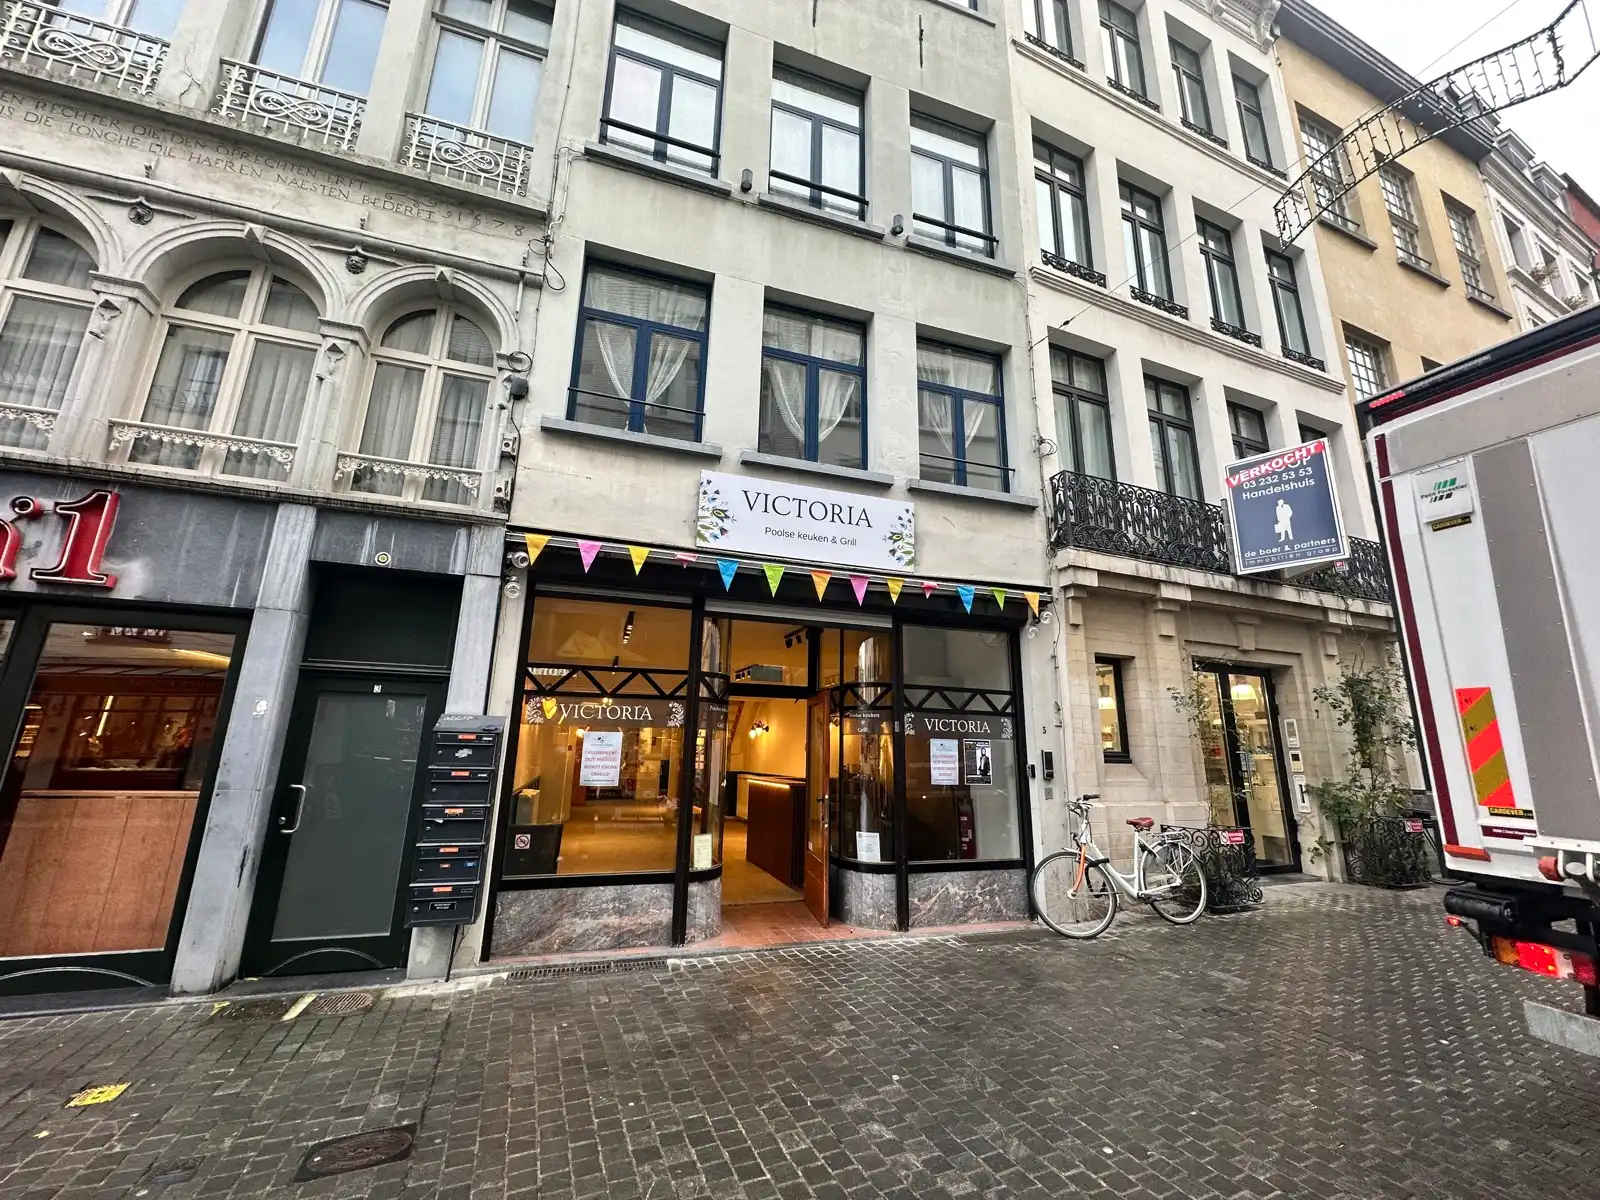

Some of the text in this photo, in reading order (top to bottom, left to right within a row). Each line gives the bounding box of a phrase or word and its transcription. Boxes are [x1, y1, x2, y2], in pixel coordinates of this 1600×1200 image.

[131, 123, 161, 140] DIE
[23, 111, 56, 128] DIE
[148, 142, 177, 158] DIE
[276, 173, 351, 200] NAESTEN
[1228, 442, 1319, 487] VERKOCHT
[1242, 467, 1313, 489] 03 232 53 53
[1242, 478, 1315, 500] Handelshuis
[741, 489, 873, 529] VICTORIA
[764, 526, 857, 547] Poolse keuken & Grill
[1258, 547, 1281, 555] boer
[1293, 537, 1337, 551] partners
[1306, 546, 1338, 557] groep
[559, 703, 653, 721] VICTORIA
[924, 718, 991, 734] VICTORIA
[1042, 726, 1047, 735] 5
